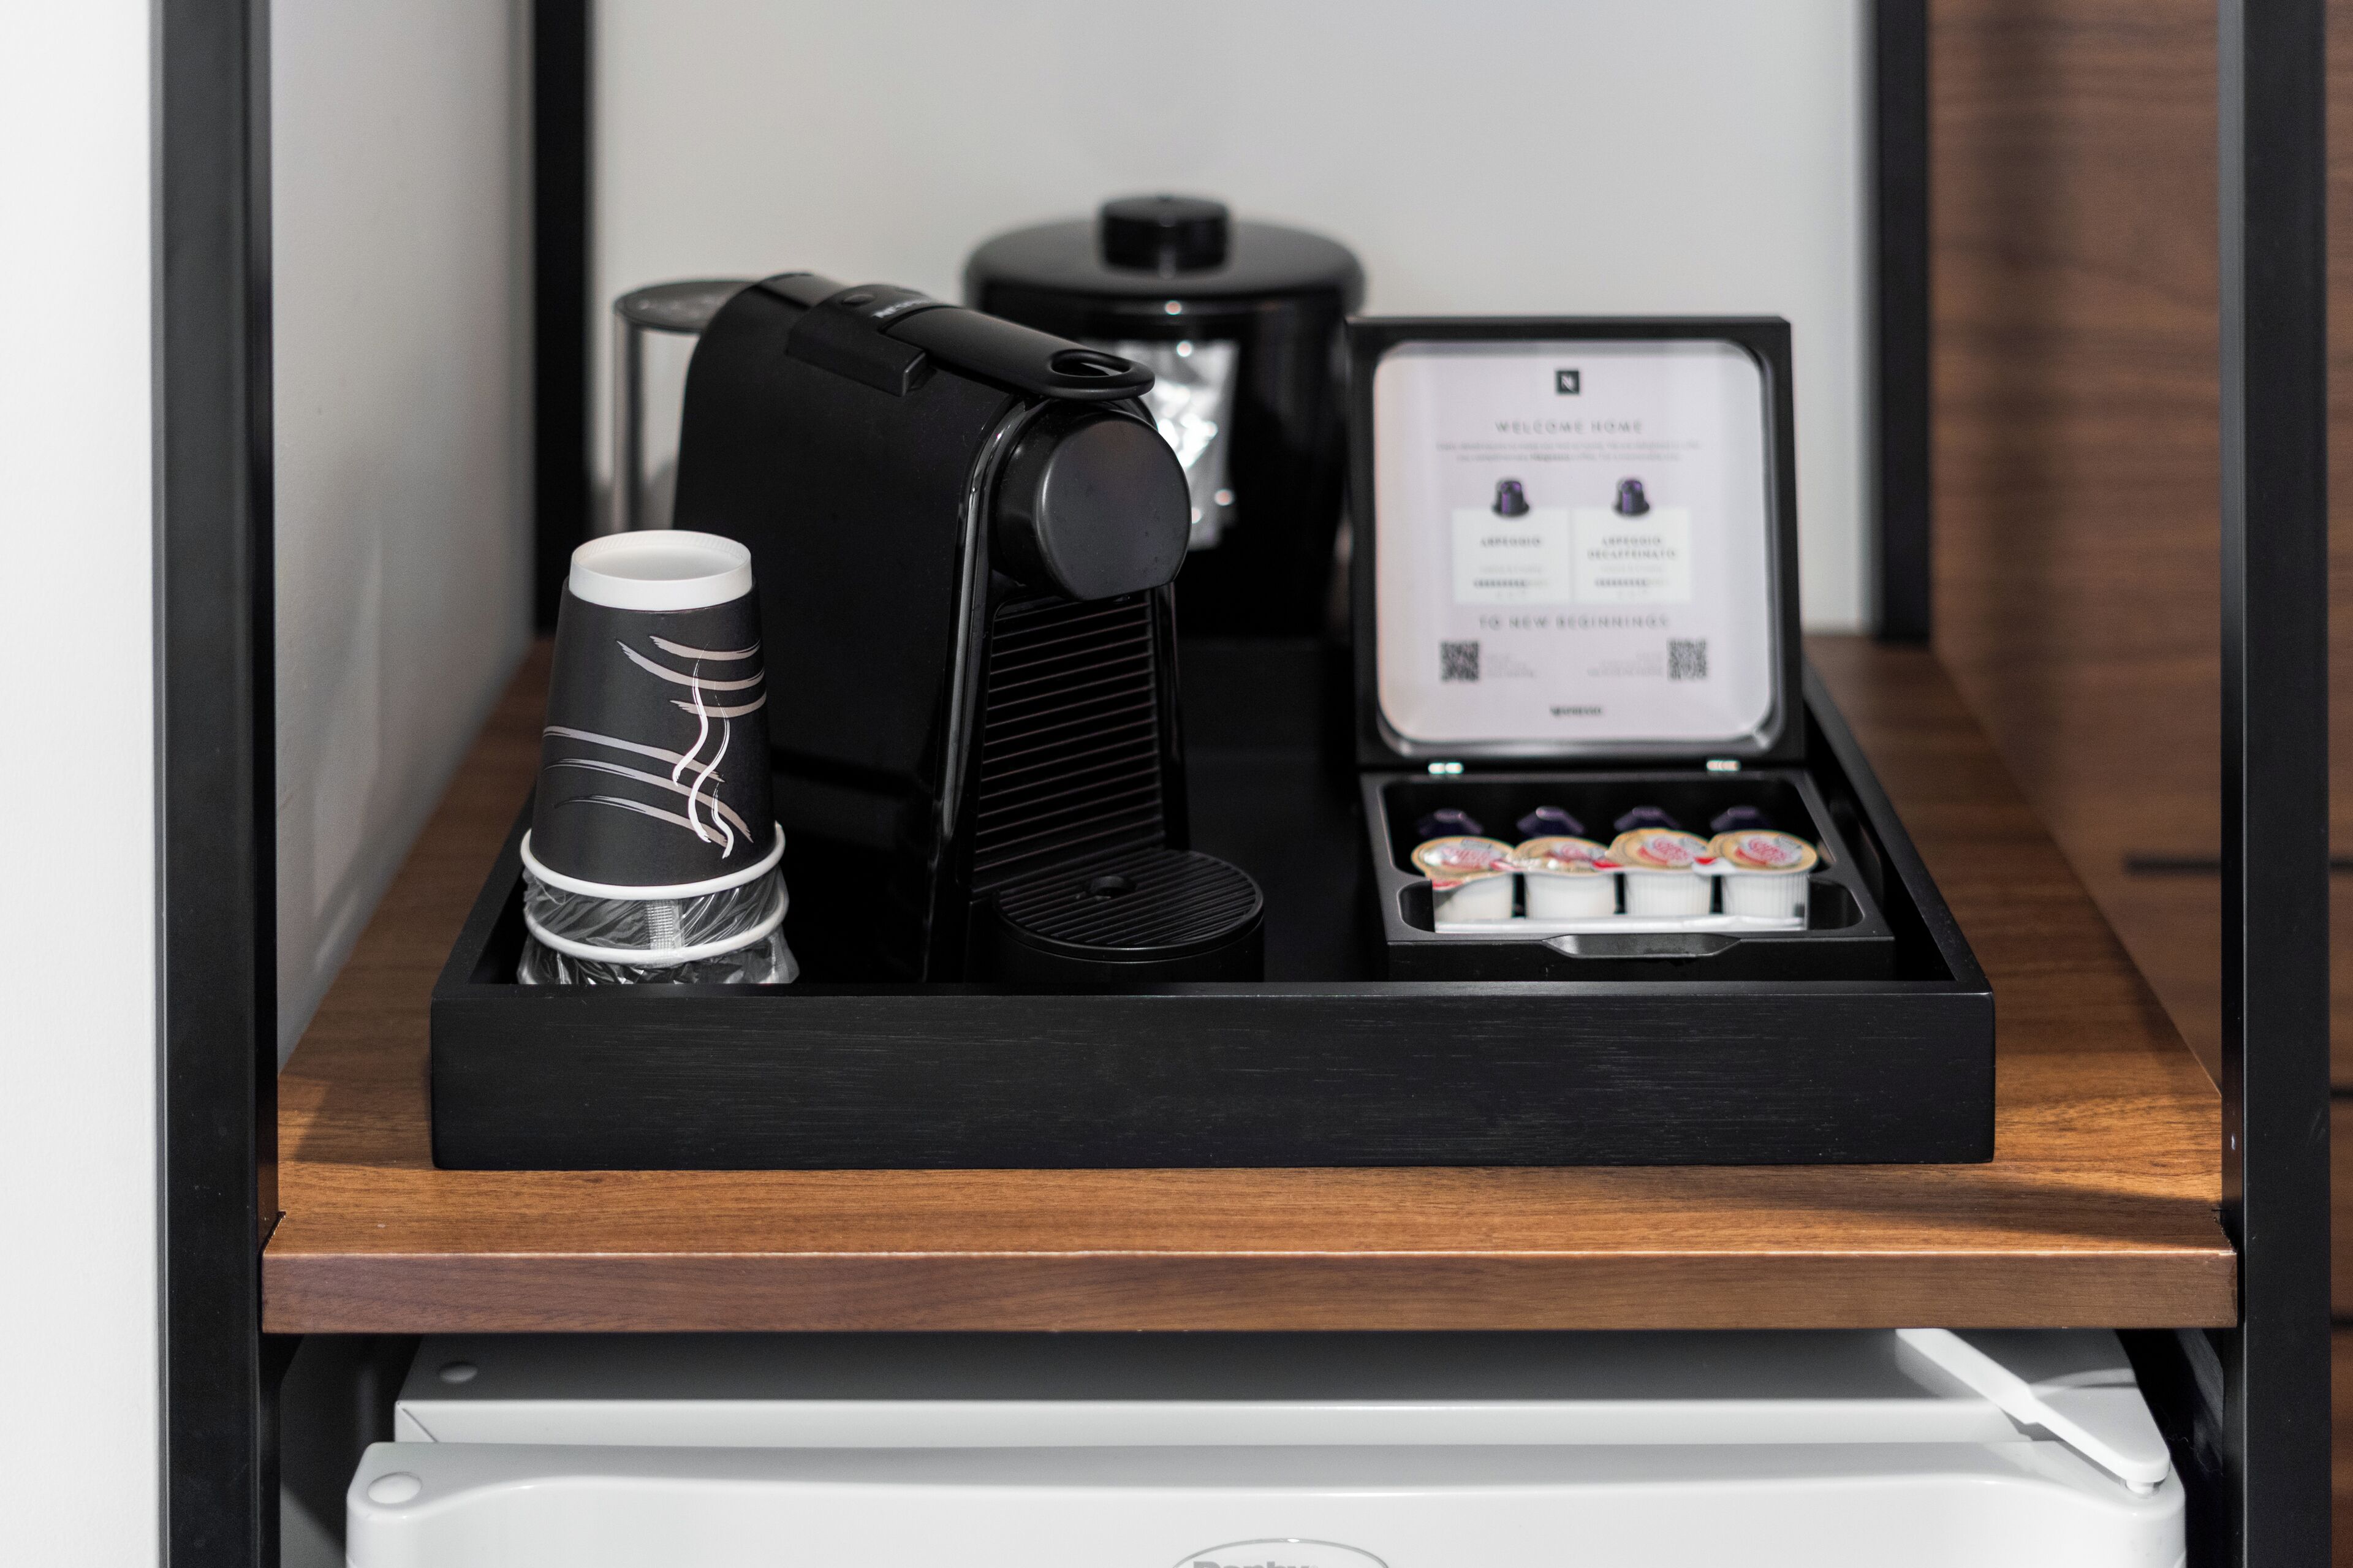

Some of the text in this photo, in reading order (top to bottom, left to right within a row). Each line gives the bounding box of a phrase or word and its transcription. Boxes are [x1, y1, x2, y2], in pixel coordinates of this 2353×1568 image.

[1495, 420, 1643, 434] WELCOME HOME
[1479, 614, 1670, 629] TO NEW BEGINNINGS
